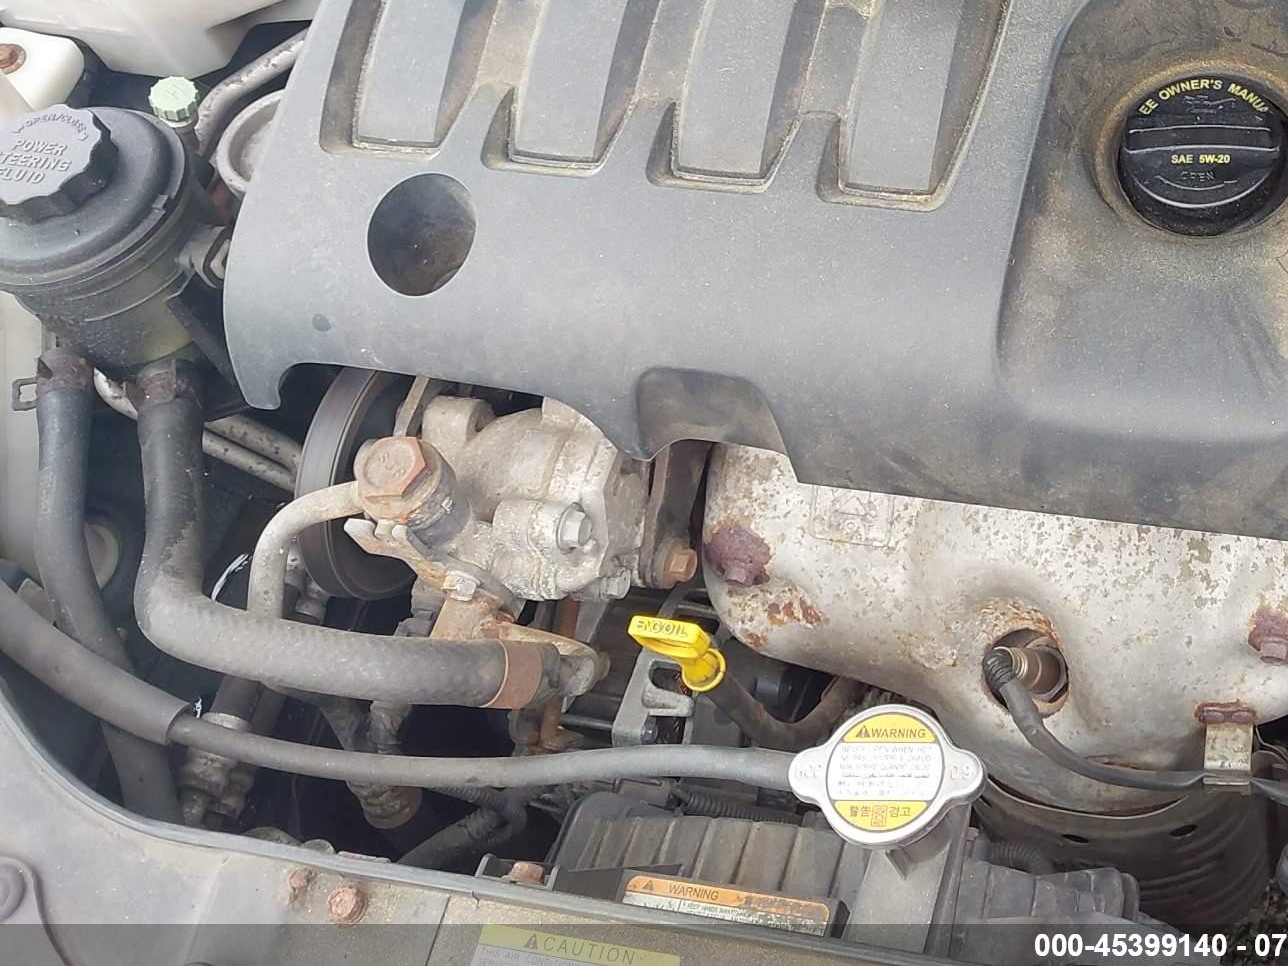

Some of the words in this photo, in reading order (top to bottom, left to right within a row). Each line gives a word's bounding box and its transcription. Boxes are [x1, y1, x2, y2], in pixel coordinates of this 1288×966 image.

[1158, 79, 1223, 100] OWNER'S
[12, 139, 68, 156] POWER
[0, 150, 73, 172] TEERING
[1171, 154, 1193, 164] SAE
[1199, 154, 1231, 164] 5W-20
[871, 728, 926, 738] WARNING
[668, 883, 720, 901] WARNING
[543, 936, 636, 965] CAUTION
